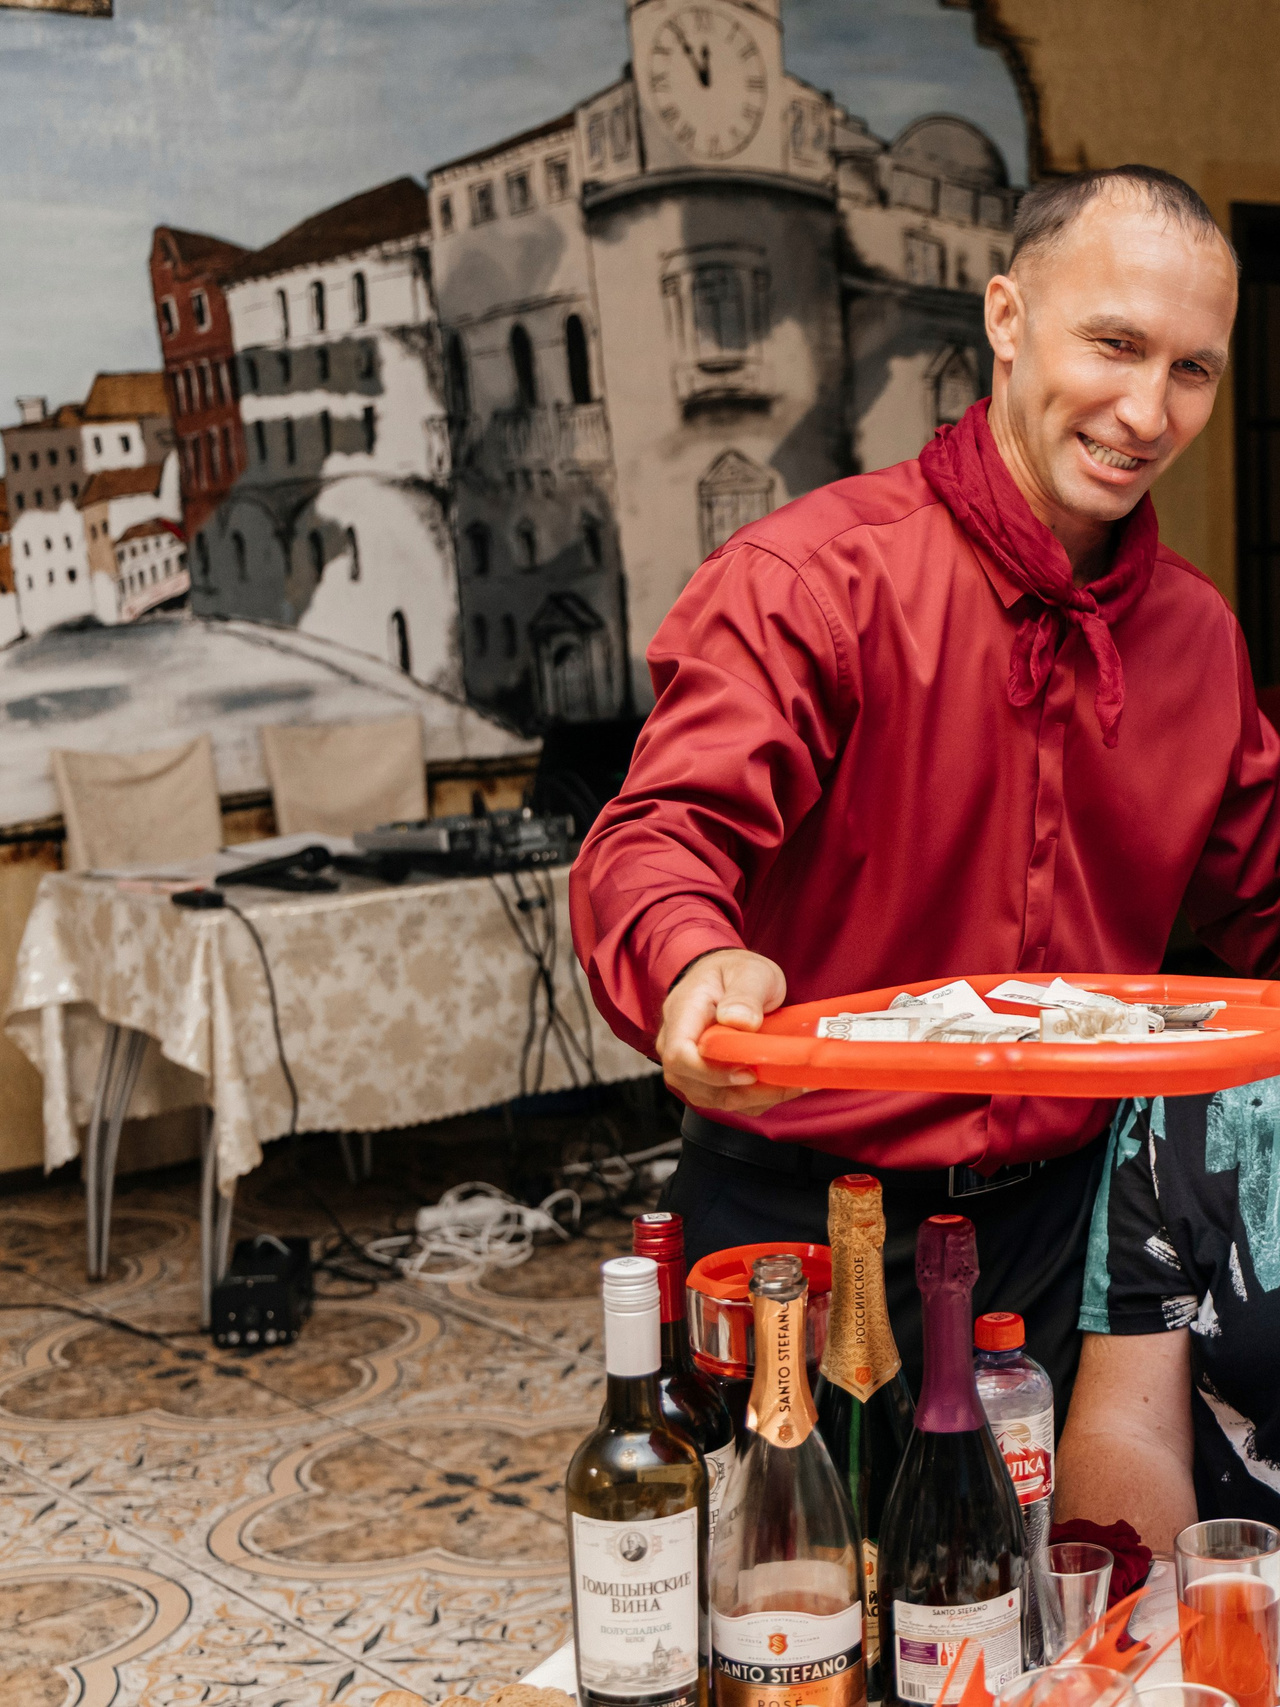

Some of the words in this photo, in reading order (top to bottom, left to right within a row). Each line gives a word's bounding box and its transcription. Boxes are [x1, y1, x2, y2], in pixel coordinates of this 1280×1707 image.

[852, 1256, 866, 1344] РОССИЙСКОЕ
[778, 1366, 791, 1413] SANTO
[582, 1571, 691, 1597] ГОЛИЦЫНСКИЕ
[611, 1598, 662, 1613] ВИНА
[932, 1608, 956, 1616] SANTO
[957, 1604, 988, 1615] STEFANO
[600, 1622, 673, 1636] ПОЛУСЛАДКОЕ
[718, 1656, 765, 1682] SANTO
[770, 1654, 848, 1683] STEFANO
